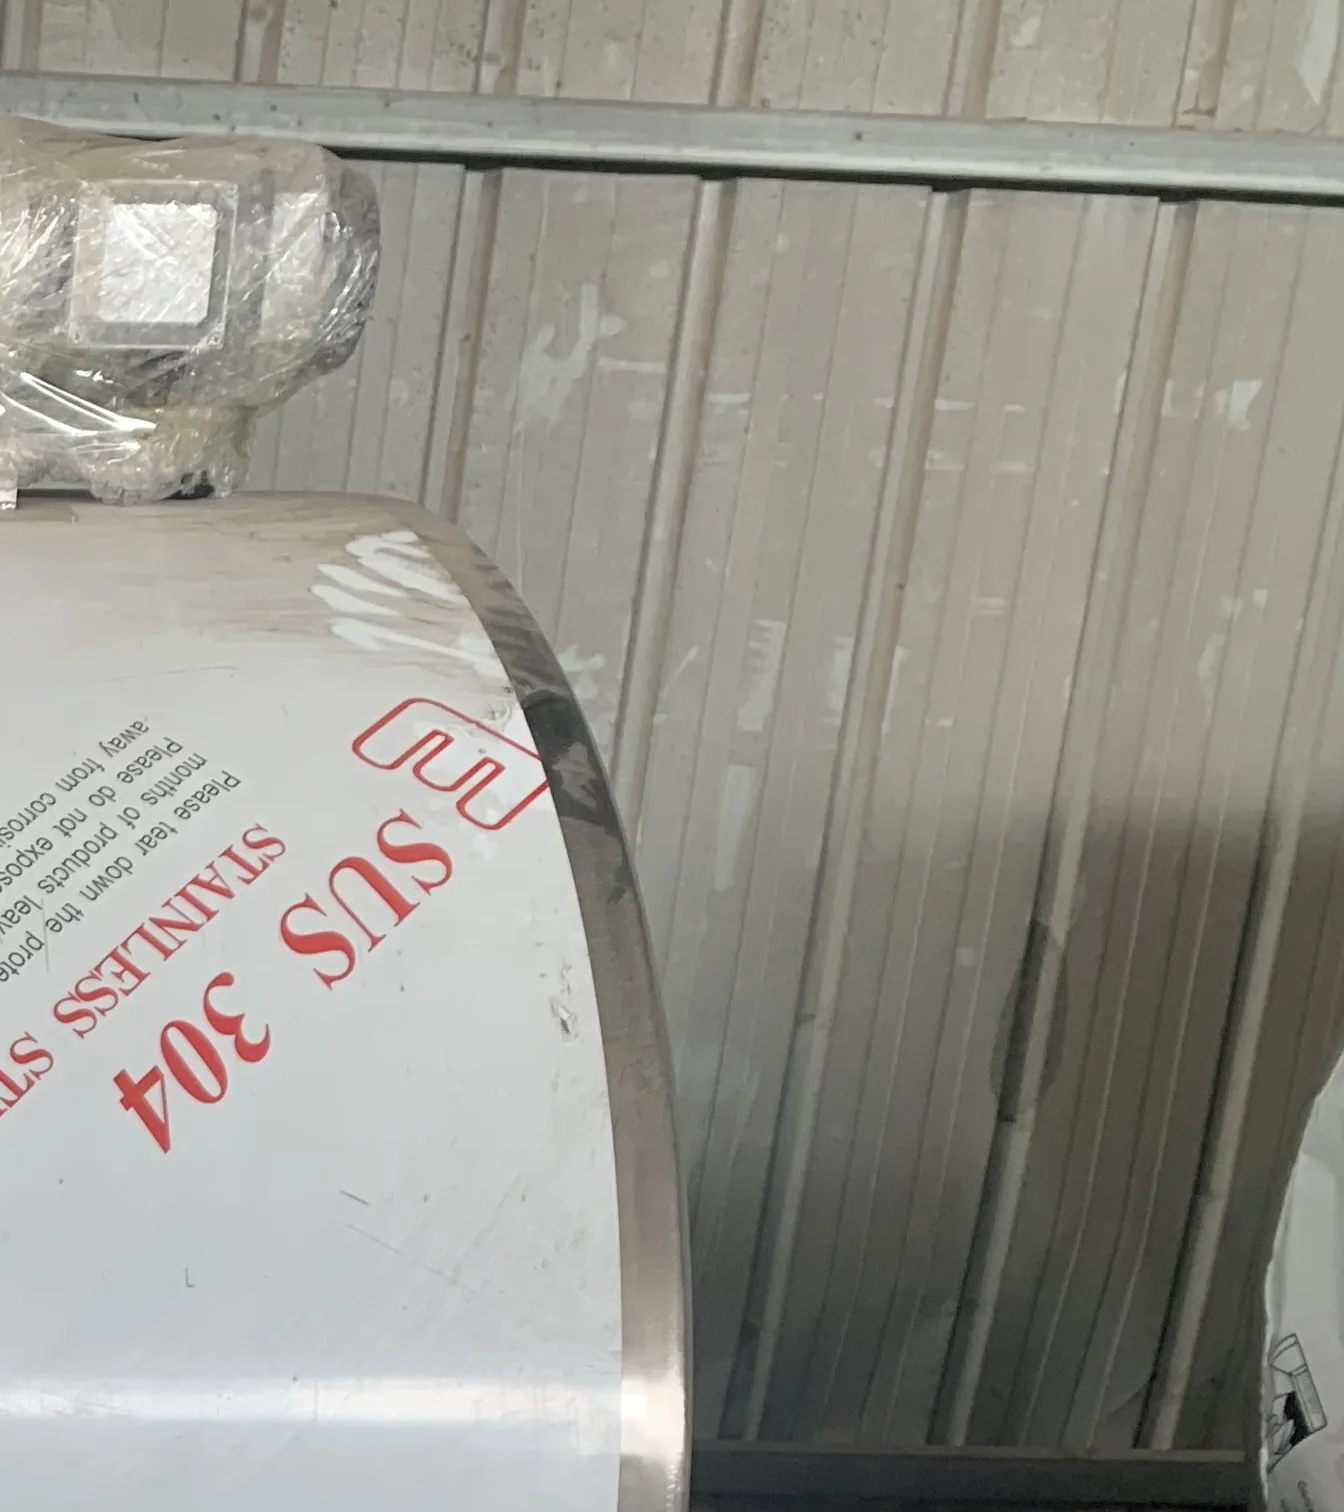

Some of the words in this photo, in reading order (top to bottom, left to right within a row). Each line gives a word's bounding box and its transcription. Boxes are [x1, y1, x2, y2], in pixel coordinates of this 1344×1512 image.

[115, 735, 184, 785] Please
[86, 784, 117, 808] do
[172, 769, 242, 821] Please
[51, 806, 89, 839] not
[133, 820, 179, 857] tear
[78, 855, 134, 902] down
[279, 811, 454, 990] SUS
[42, 901, 85, 934] the
[52, 822, 286, 1040] STAINLESS
[112, 971, 271, 1154] 304
